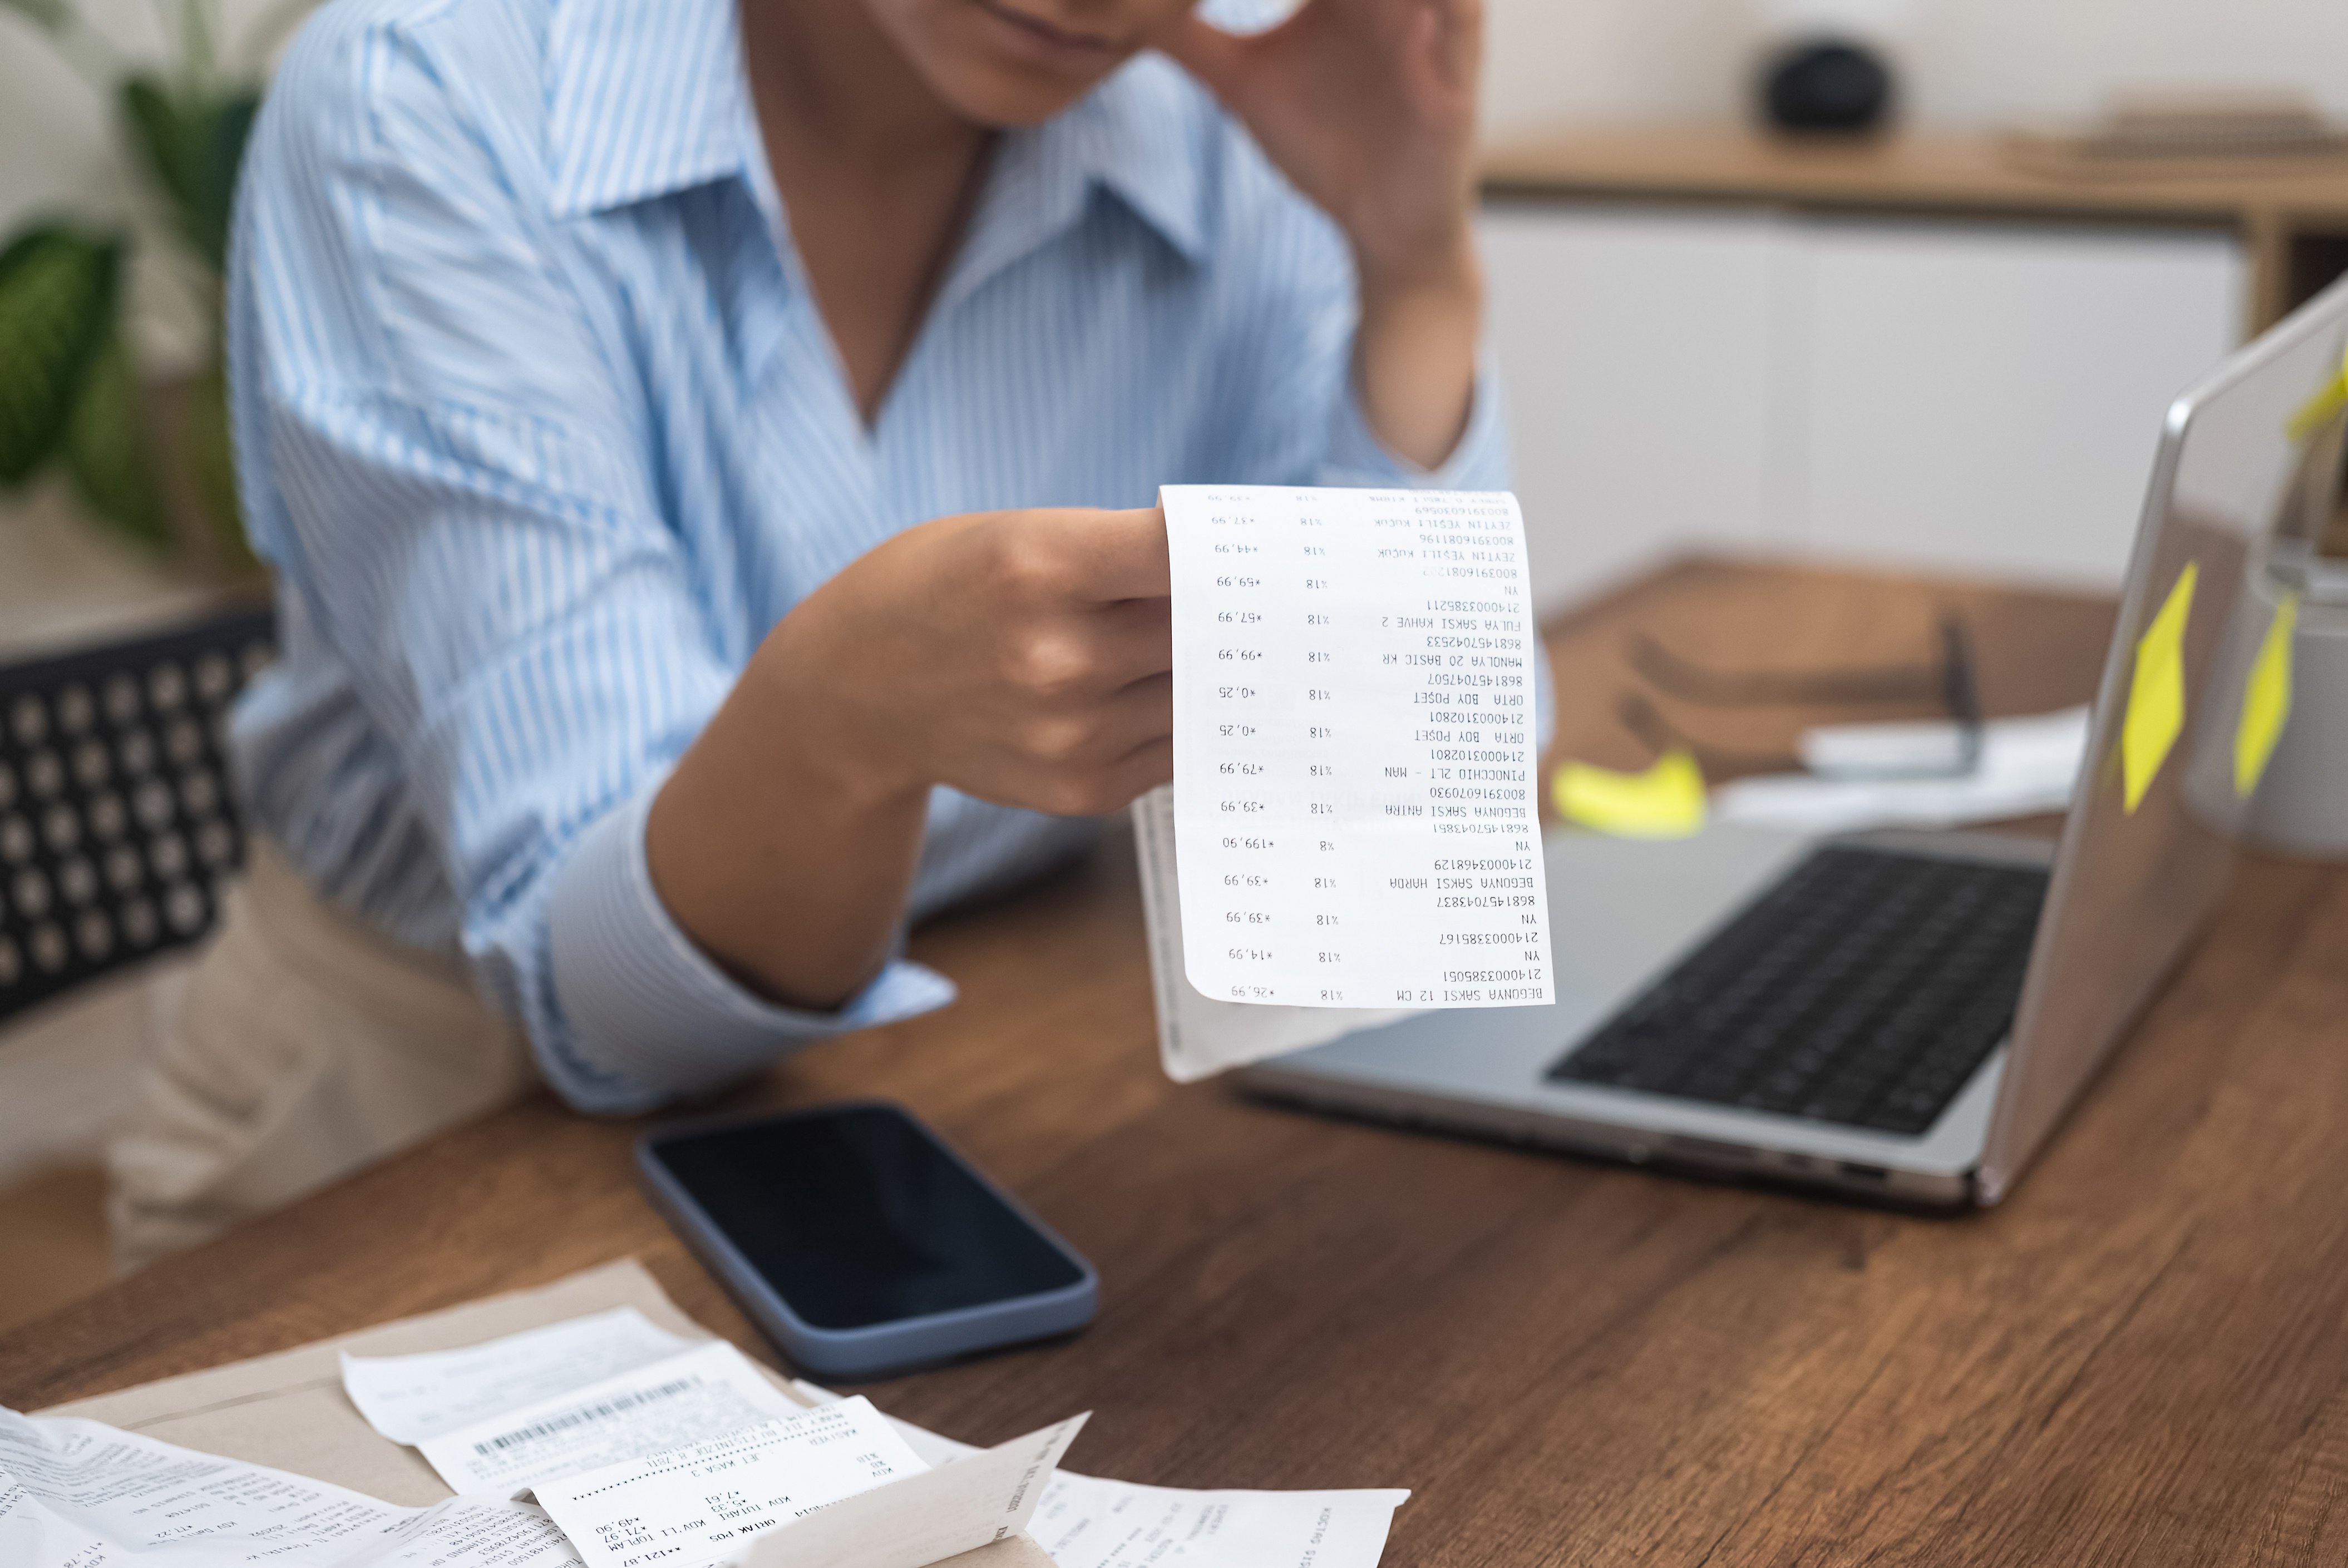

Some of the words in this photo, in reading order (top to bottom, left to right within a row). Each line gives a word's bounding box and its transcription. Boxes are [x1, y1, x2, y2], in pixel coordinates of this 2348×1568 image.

[1415, 507, 1509, 516] 8003916030569
[1419, 534, 1514, 546] 8003916081196
[1504, 585, 1518, 596] YN
[1427, 600, 1520, 614] 2140003385211
[1382, 616, 1389, 627] 2
[1397, 617, 1433, 629] KAHVE
[1442, 619, 1477, 630] SAKSI
[1484, 620, 1521, 632] FULYA
[1427, 636, 1521, 650] 8681457042533
[1383, 654, 1397, 665] KR
[1405, 654, 1441, 666] BASIC
[1449, 655, 1463, 667] 20
[1471, 656, 1522, 668] MANOLYA
[1428, 673, 1523, 687] 8681457047507
[1413, 691, 1449, 704] POŞET
[1458, 694, 1478, 705] BOY
[1494, 694, 1523, 706] ORTA
[1430, 711, 1523, 725] 2140003102801
[1414, 729, 1451, 742] POŞET
[1458, 731, 1479, 743] BOY
[1494, 732, 1524, 744] ORTA
[1432, 749, 1524, 763] 2140003102801
[1385, 766, 1407, 778] MAN
[1430, 768, 1451, 780] 2LT
[1459, 769, 1525, 781] PINOCCHIO
[1430, 787, 1525, 800] 8003916070930
[1385, 805, 1422, 817] ANTRA
[1431, 806, 1467, 818] SAKSI
[1474, 807, 1526, 818] BEGONYA
[1433, 824, 1529, 834] 8681457043851
[1516, 840, 1531, 852] YN
[1434, 859, 1532, 870] 2140003468129
[1390, 878, 1428, 889] HARDA
[1436, 878, 1473, 889] SAKSI
[1481, 877, 1533, 889] BEGONYA
[1437, 896, 1535, 908] 8681457043837
[1522, 913, 1537, 924] YN
[1439, 932, 1538, 945] 2140003385167
[1525, 950, 1540, 961] YN
[1444, 968, 1541, 982] 2140003385051
[1397, 990, 1412, 1001] CM
[1420, 990, 1433, 1002] 12
[1444, 990, 1481, 1001] SAKSI
[1489, 988, 1542, 1000] BEGONYA
[742, 1453, 760, 1464] JET
[704, 1460, 736, 1473] KASA
[768, 1496, 791, 1507] KDV
[718, 1504, 761, 1521] TUTARI
[216, 1521, 238, 1530] KDV
[490, 1514, 540, 1537] BRUSSELS
[737, 1519, 776, 1534] ORTAK
[709, 1531, 734, 1541] POS
[446, 1537, 491, 1558] DIAMOND
[608, 1534, 654, 1552] TOPLAM
[429, 1558, 446, 1567] OR
